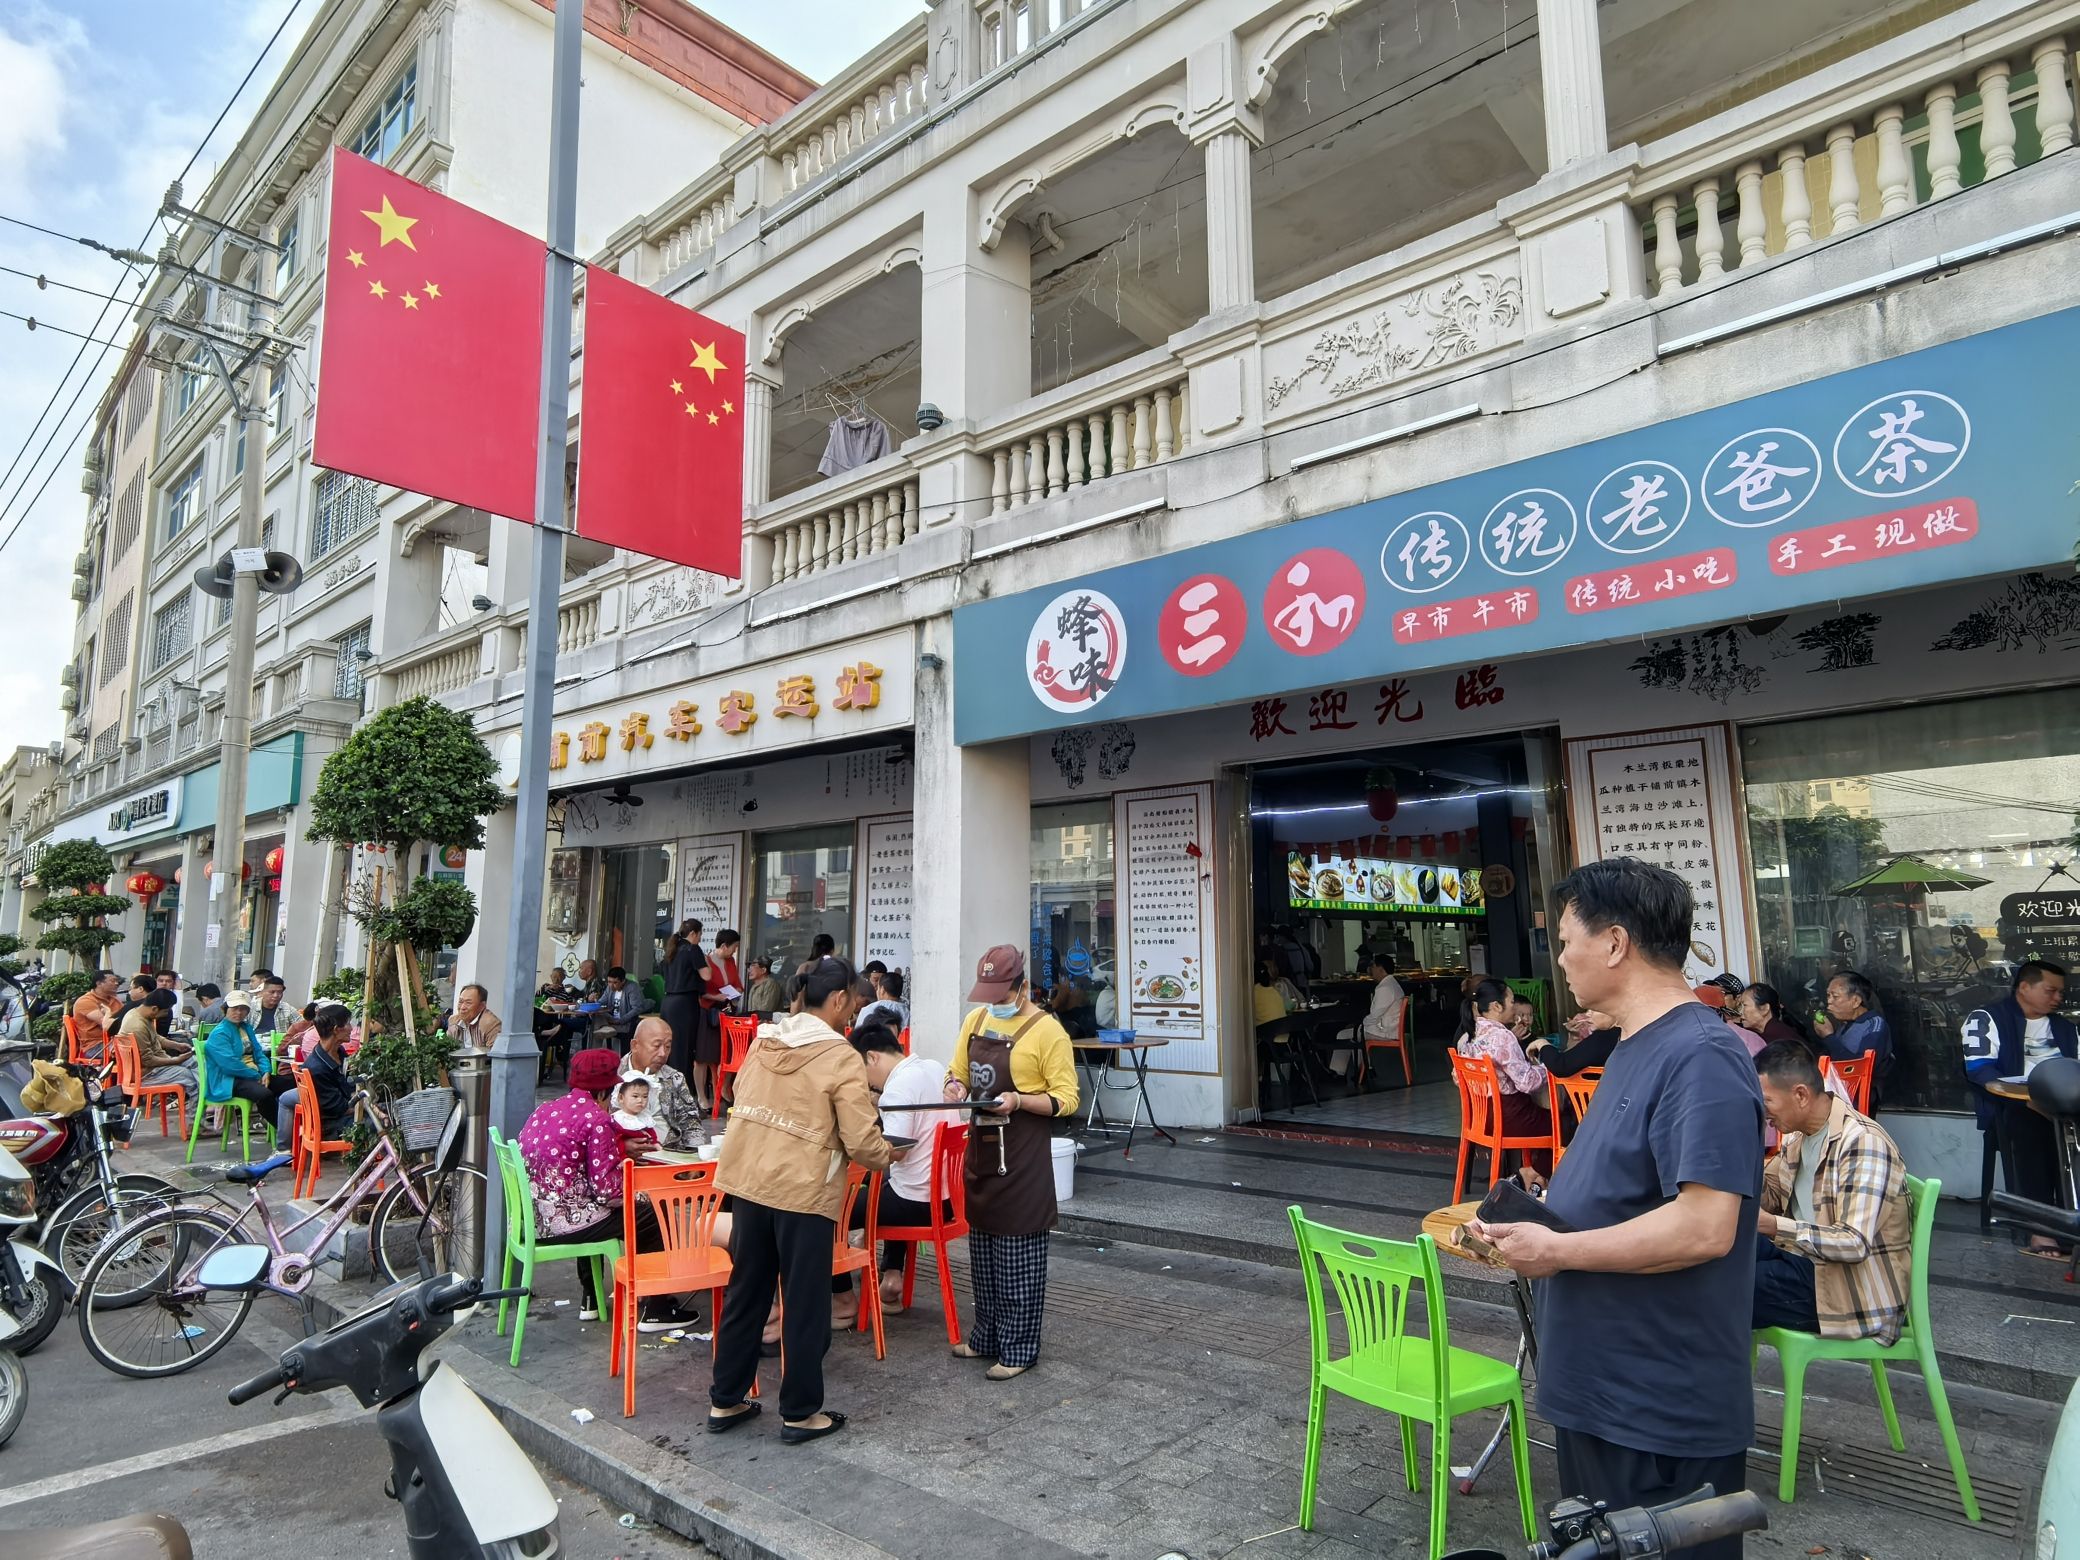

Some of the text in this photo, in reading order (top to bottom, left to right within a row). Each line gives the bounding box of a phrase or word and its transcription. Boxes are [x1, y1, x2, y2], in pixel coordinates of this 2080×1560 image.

[1398, 399, 1957, 583] 传统老爸茶
[1776, 507, 1969, 569] 手工现做
[1571, 556, 1730, 609] 传统小吃
[1057, 596, 1117, 702] 蜂味
[1623, 757, 1700, 774] 木兰湾板栗地
[1602, 818, 1705, 834] 有独特的成长环境
[1692, 921, 1717, 932] 天花
[1963, 1011, 1992, 1058] 3
